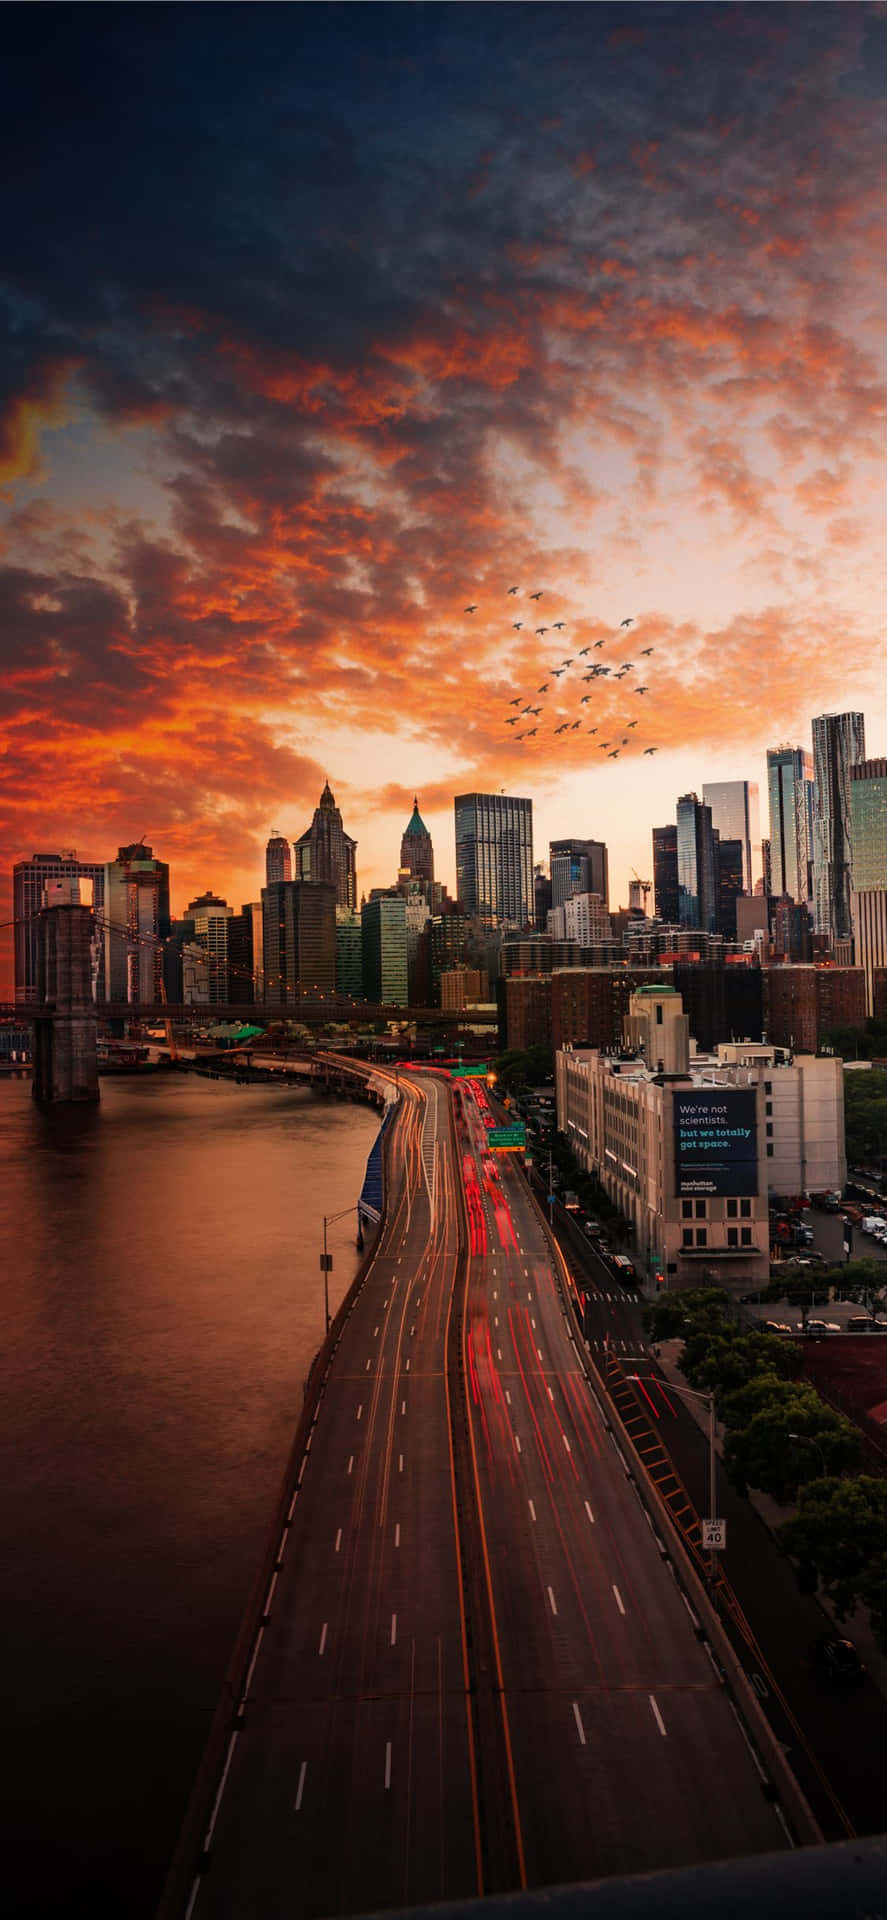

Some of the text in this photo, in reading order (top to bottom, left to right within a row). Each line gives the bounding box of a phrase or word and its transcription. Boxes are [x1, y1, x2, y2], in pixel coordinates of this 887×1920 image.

[680, 1105, 708, 1113] We're
[680, 1116, 728, 1125] scientists.
[680, 1129, 698, 1137] but
[716, 1128, 751, 1138] totally
[680, 1140, 731, 1151] got space.
[707, 1533, 721, 1542] 40
